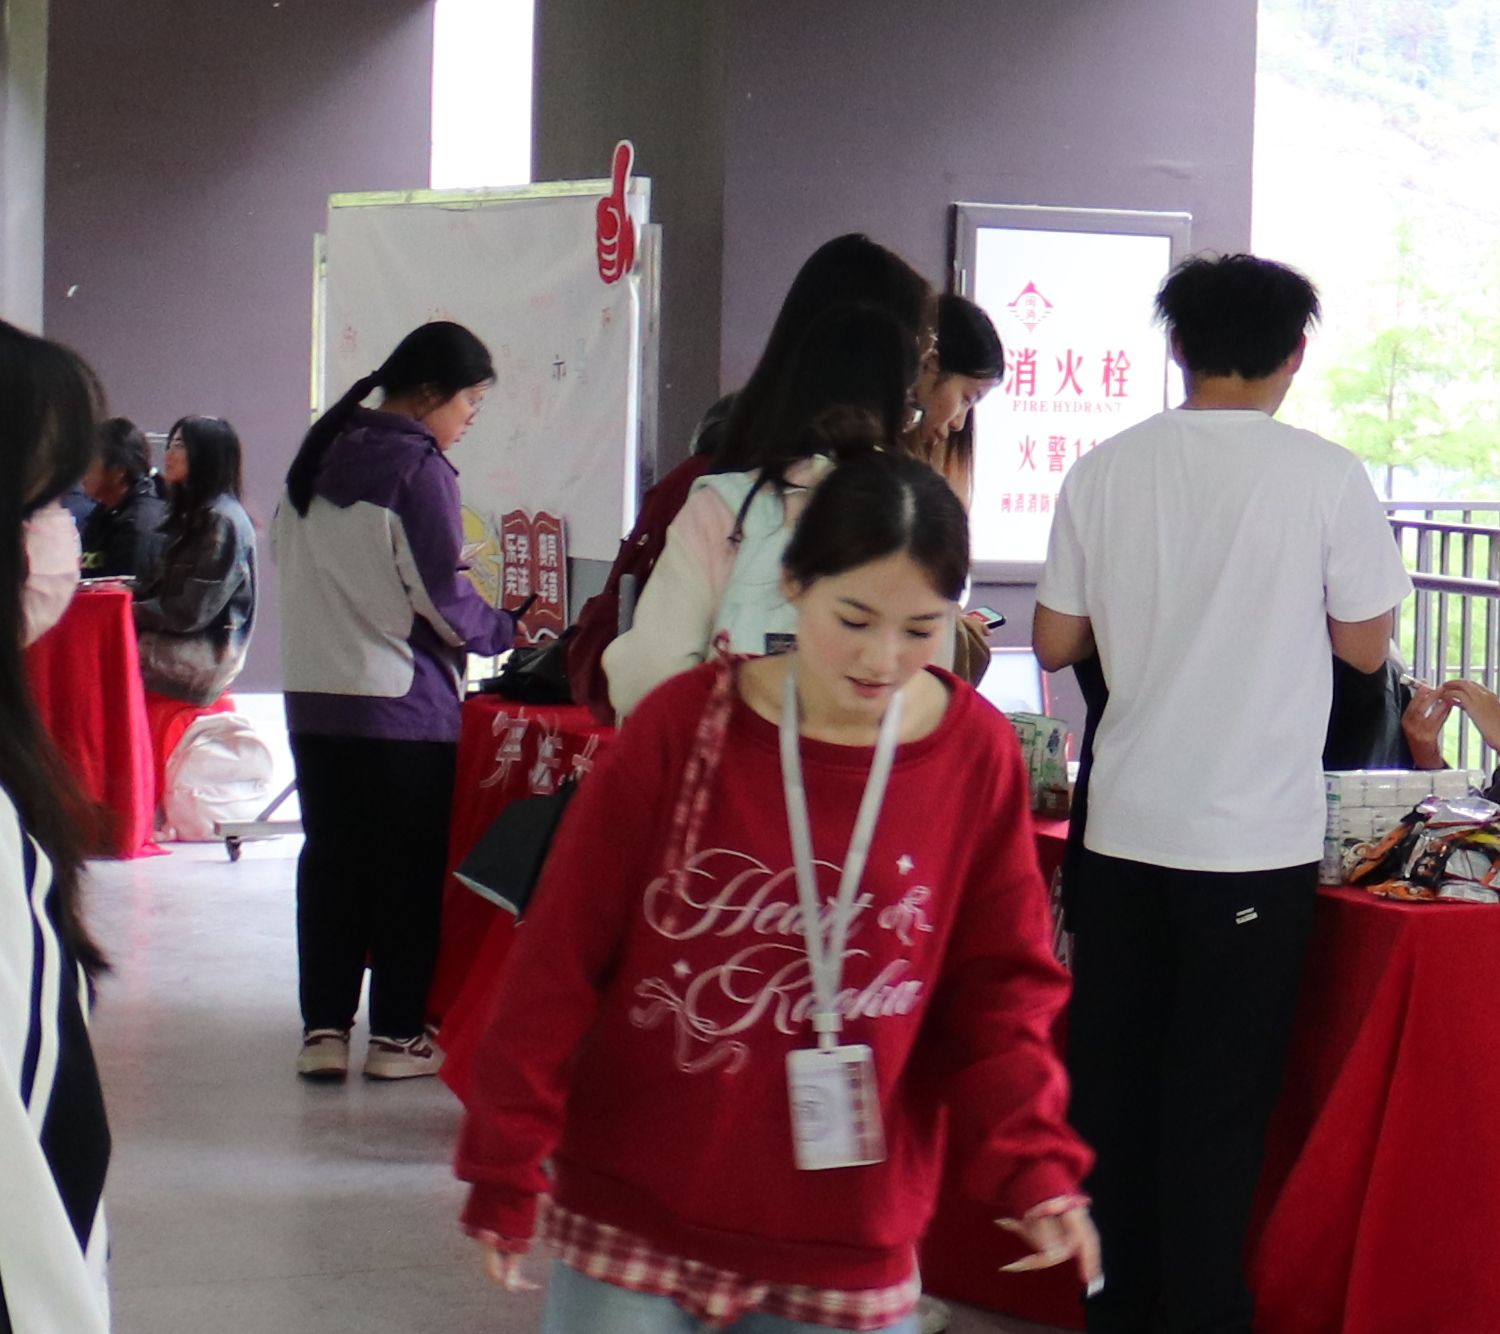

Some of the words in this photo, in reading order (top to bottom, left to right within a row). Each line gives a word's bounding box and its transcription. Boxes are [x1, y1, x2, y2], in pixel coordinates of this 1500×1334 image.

[1004, 347, 1131, 398] 消火栓
[1012, 400, 1048, 413] FIRE
[1052, 401, 1122, 414] HYDRANT
[1016, 434, 1098, 473] 火警1
